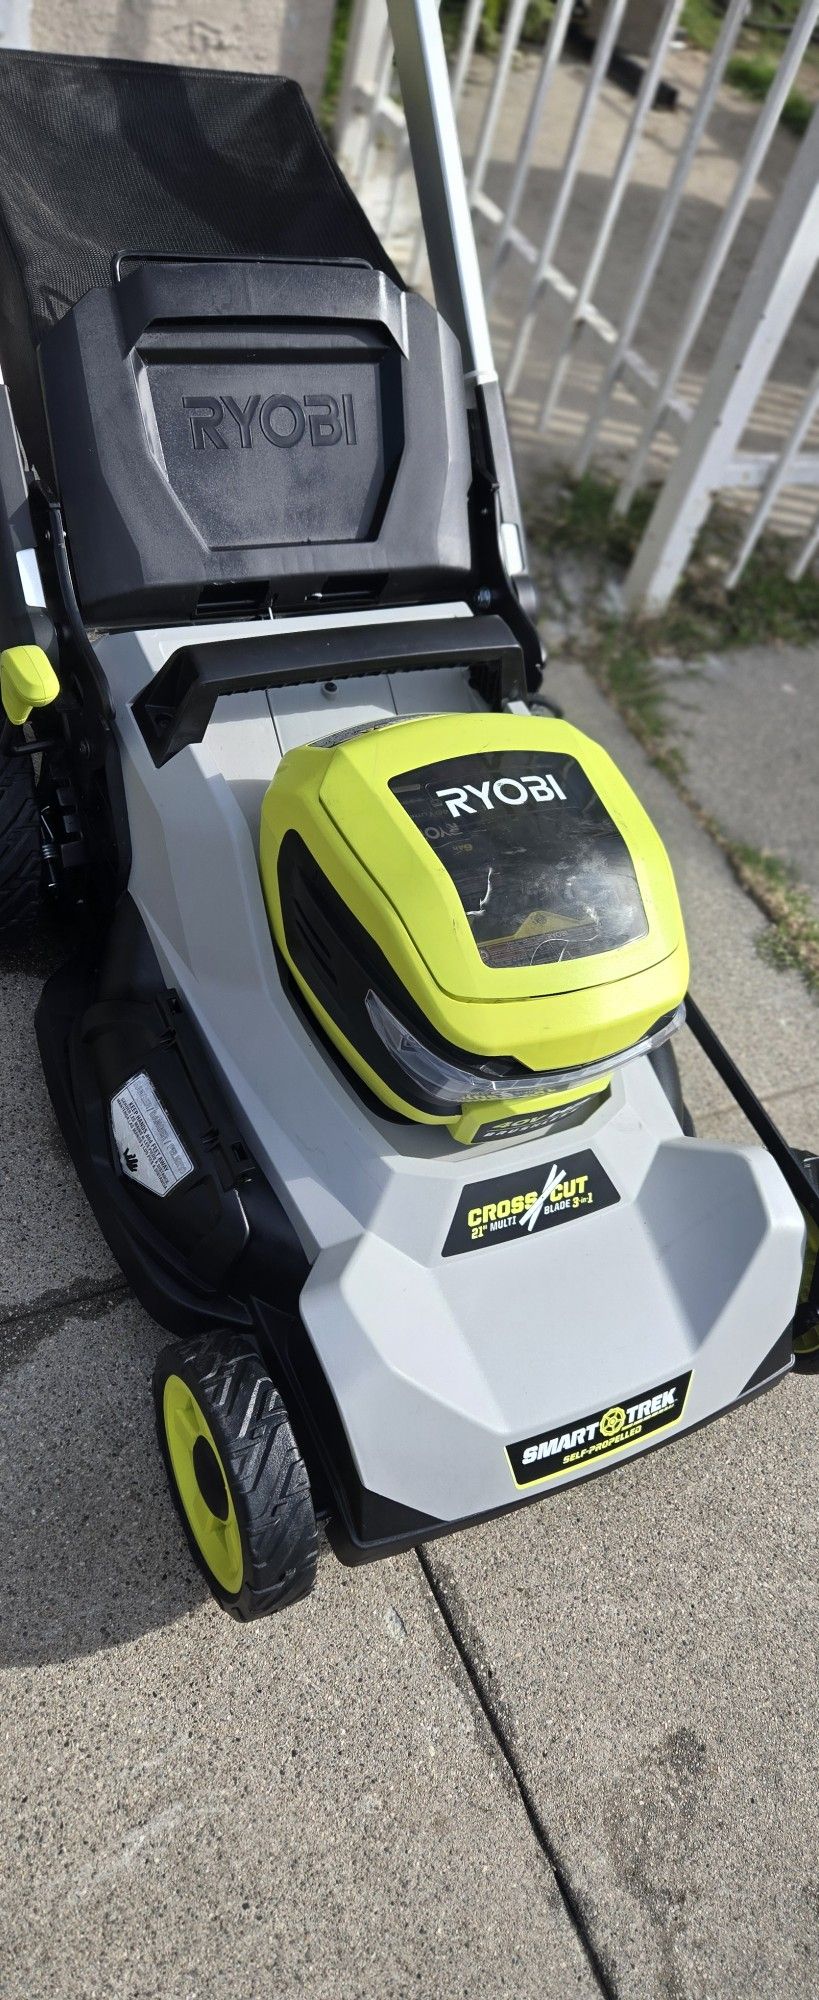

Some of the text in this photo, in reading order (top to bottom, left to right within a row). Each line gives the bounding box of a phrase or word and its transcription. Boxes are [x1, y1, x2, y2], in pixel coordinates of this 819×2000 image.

[182, 393, 357, 450] RYOBI
[436, 774, 567, 818] RYOBI
[467, 1175, 589, 1228] CROSS CUT
[490, 1216, 517, 1232] MULTI
[544, 1199, 571, 1215] BLADE
[521, 1387, 677, 1465] SMART TREK
[562, 1424, 642, 1465] SELF-PROPELLED
